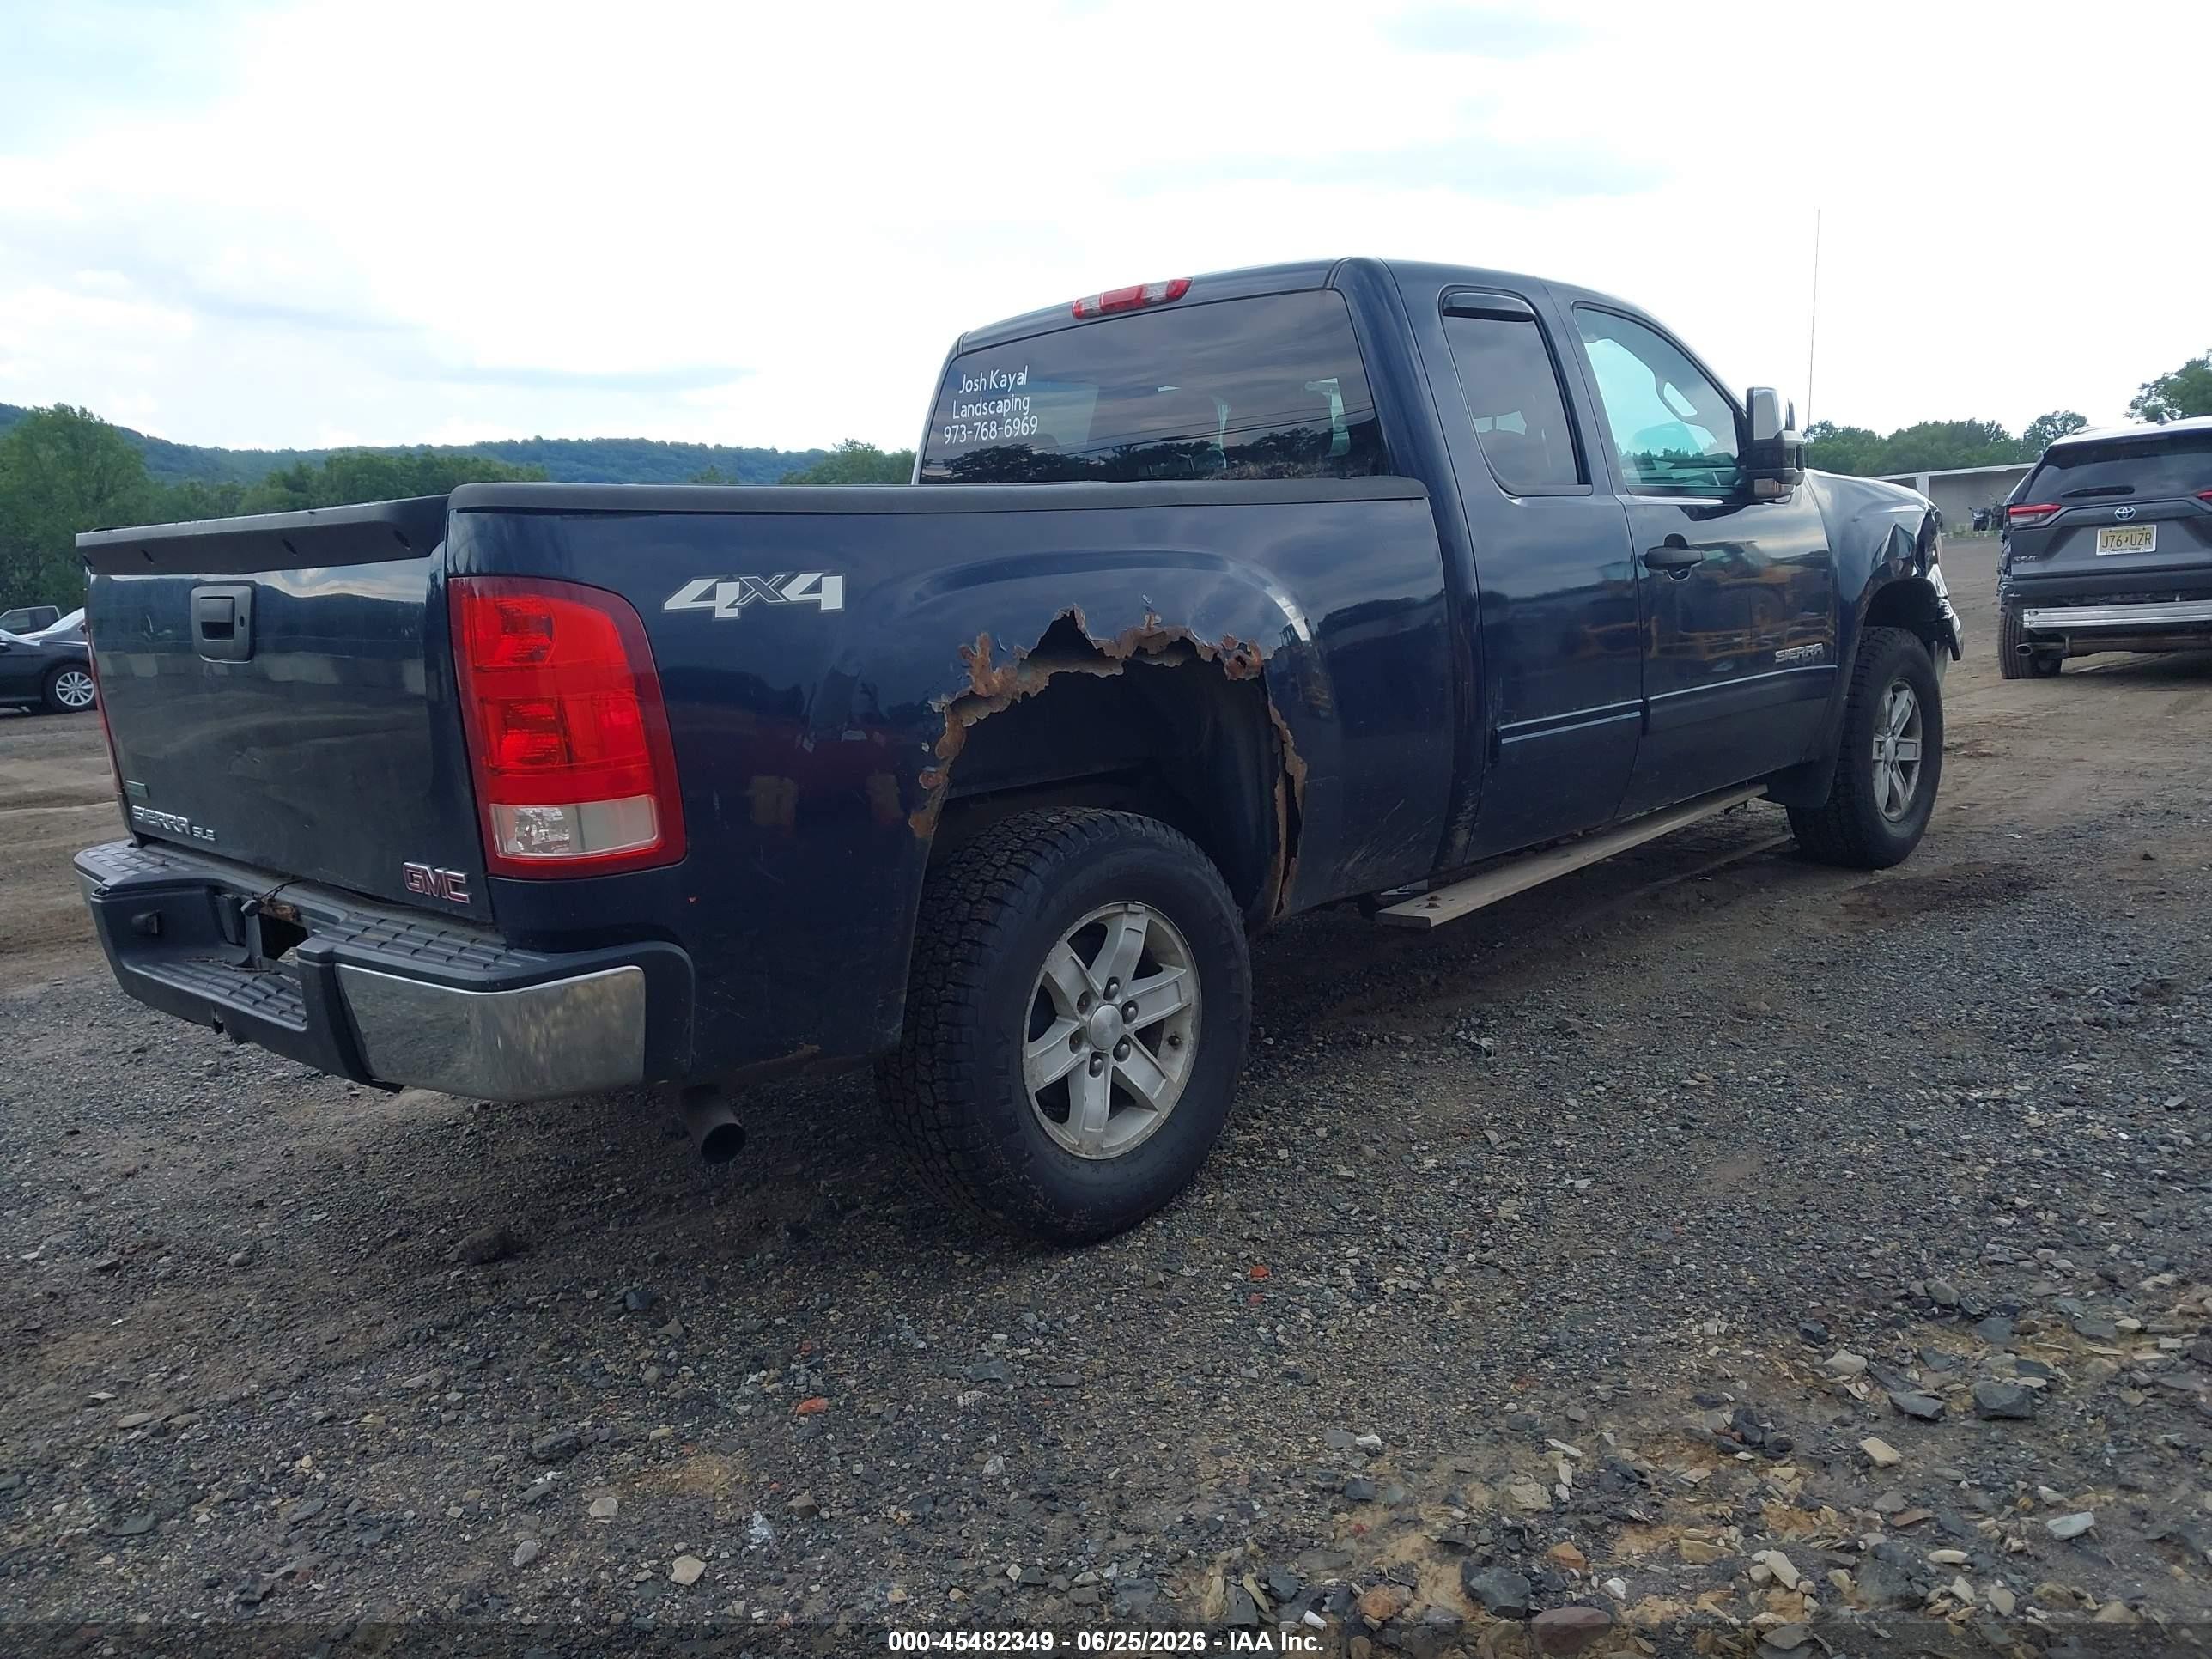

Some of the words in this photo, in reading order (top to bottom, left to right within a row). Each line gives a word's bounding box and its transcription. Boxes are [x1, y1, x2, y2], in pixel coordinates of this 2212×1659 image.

[959, 372, 987, 393] Josh
[989, 365, 1029, 392] Kayal
[952, 394, 1030, 419] Landscaping
[945, 416, 1038, 444] 973-768-6969
[1775, 643, 1824, 663] SIERRA
[131, 805, 191, 835] SIERRA
[403, 861, 471, 904] GMC
